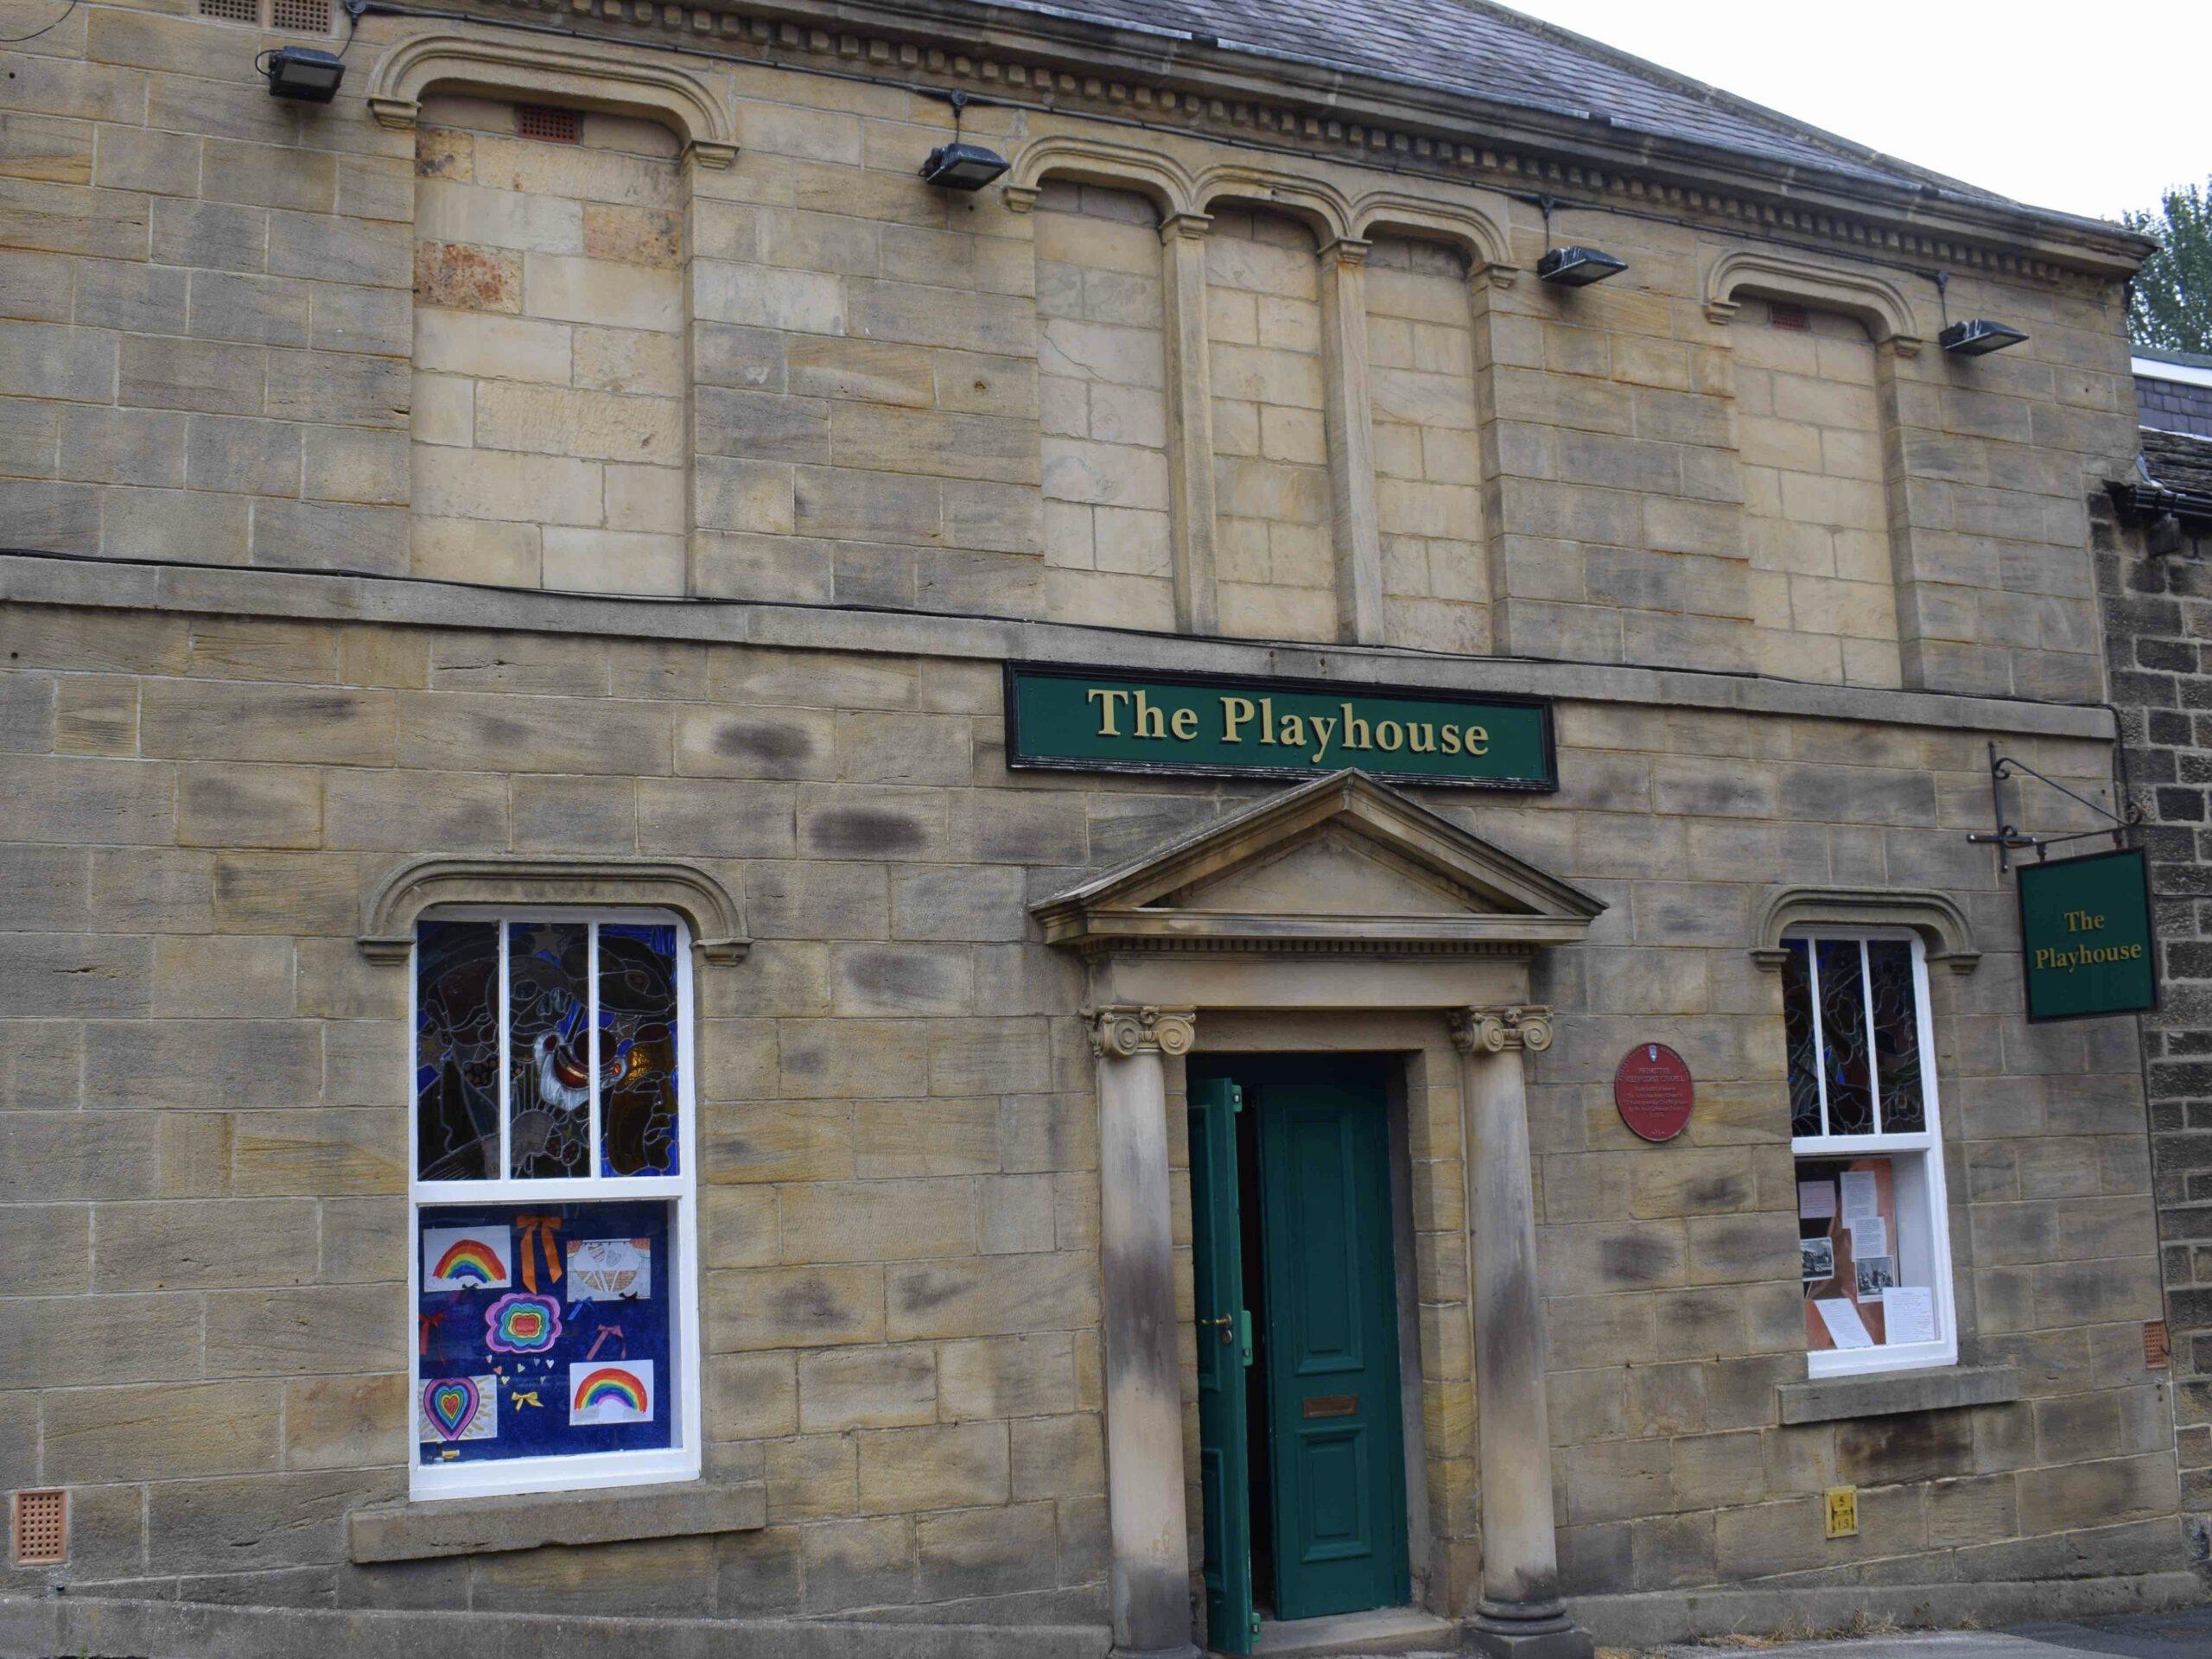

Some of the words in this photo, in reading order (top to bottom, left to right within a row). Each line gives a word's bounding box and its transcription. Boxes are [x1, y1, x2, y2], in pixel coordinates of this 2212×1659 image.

[1087, 688, 1199, 741] The
[1219, 696, 1491, 763] Playhouse
[2063, 911, 2105, 931] The
[2035, 944, 2142, 973] Playhouse
